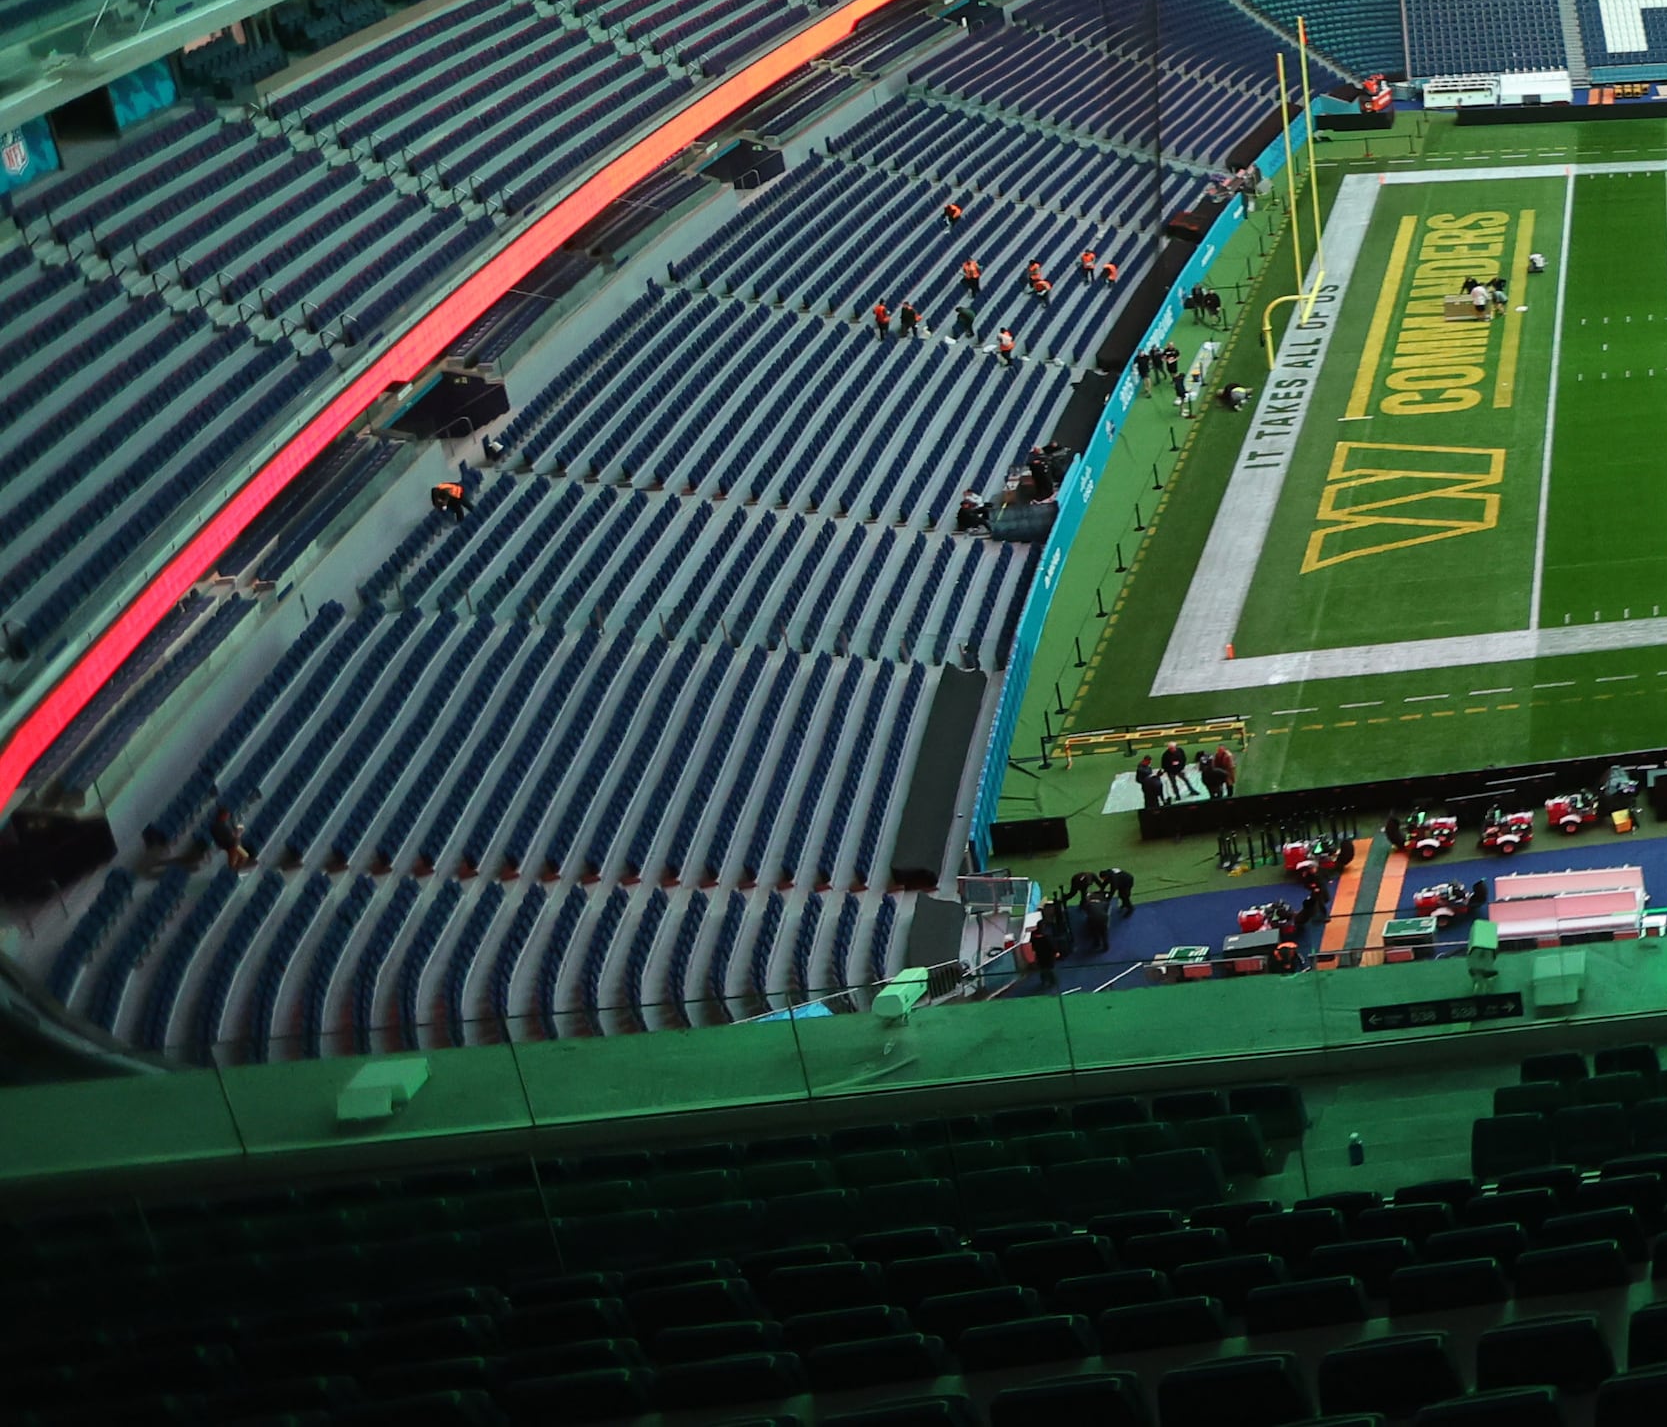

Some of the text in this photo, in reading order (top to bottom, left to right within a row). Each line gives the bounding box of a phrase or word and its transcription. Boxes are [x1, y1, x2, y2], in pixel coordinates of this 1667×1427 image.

[1243, 284, 1340, 469] IT TAKES ALL OF US
